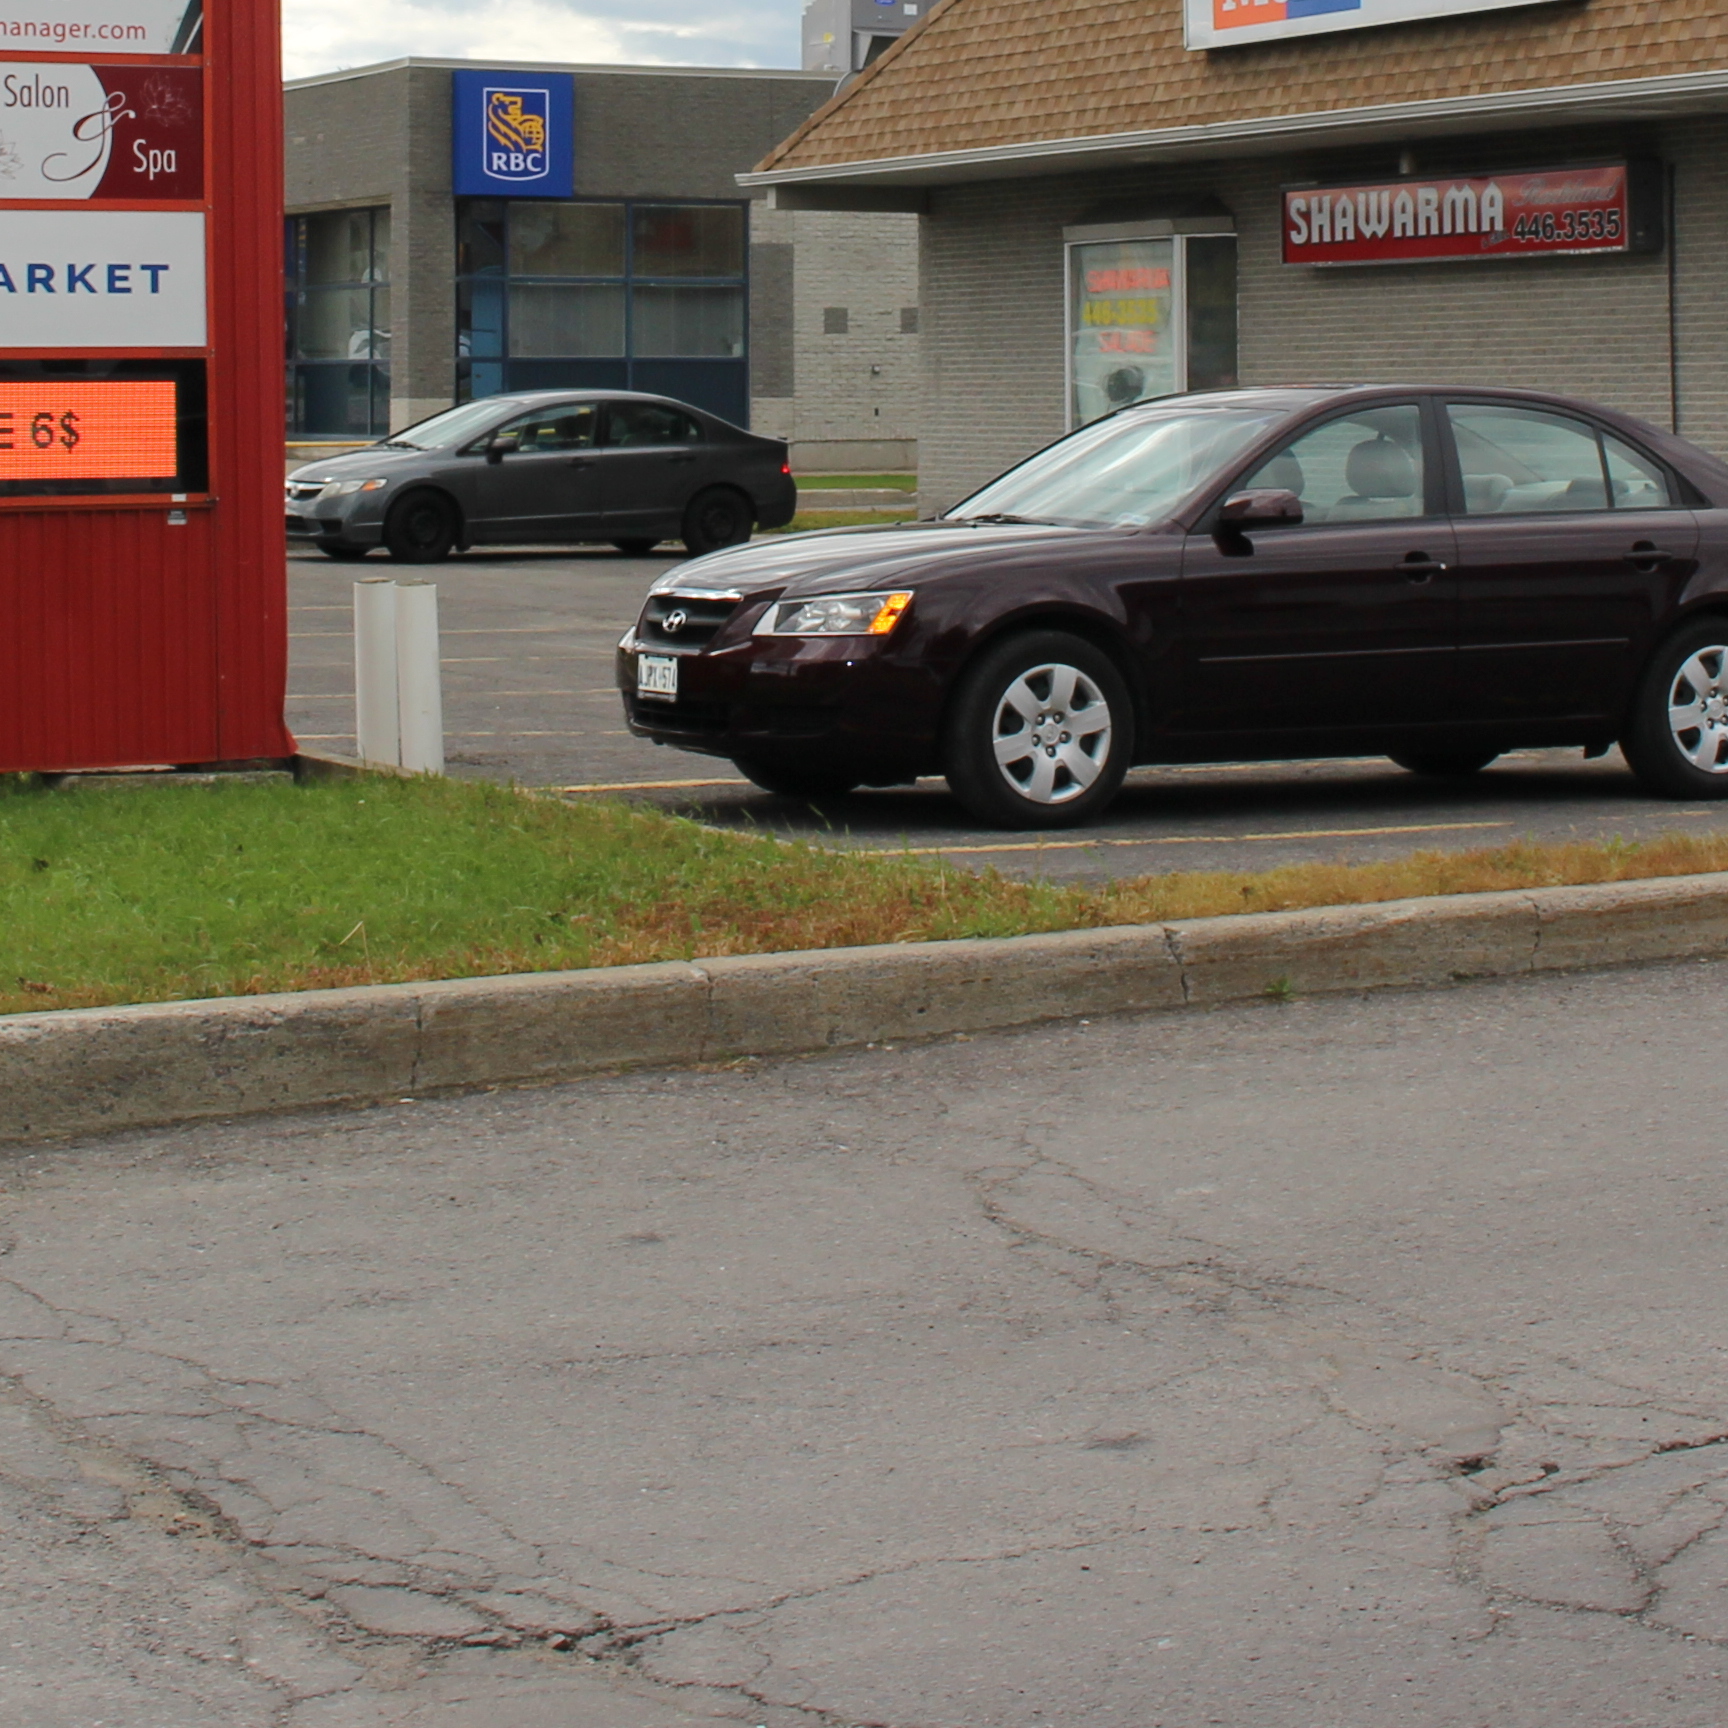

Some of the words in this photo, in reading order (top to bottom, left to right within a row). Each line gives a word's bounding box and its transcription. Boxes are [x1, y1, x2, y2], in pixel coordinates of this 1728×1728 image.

[2, 74, 71, 110] Salon
[132, 139, 178, 179] Spa
[491, 151, 543, 173] RBC
[1289, 181, 1505, 246] SHAWARMA
[1513, 208, 1622, 242] 446.3535
[31, 409, 82, 451] 6$
